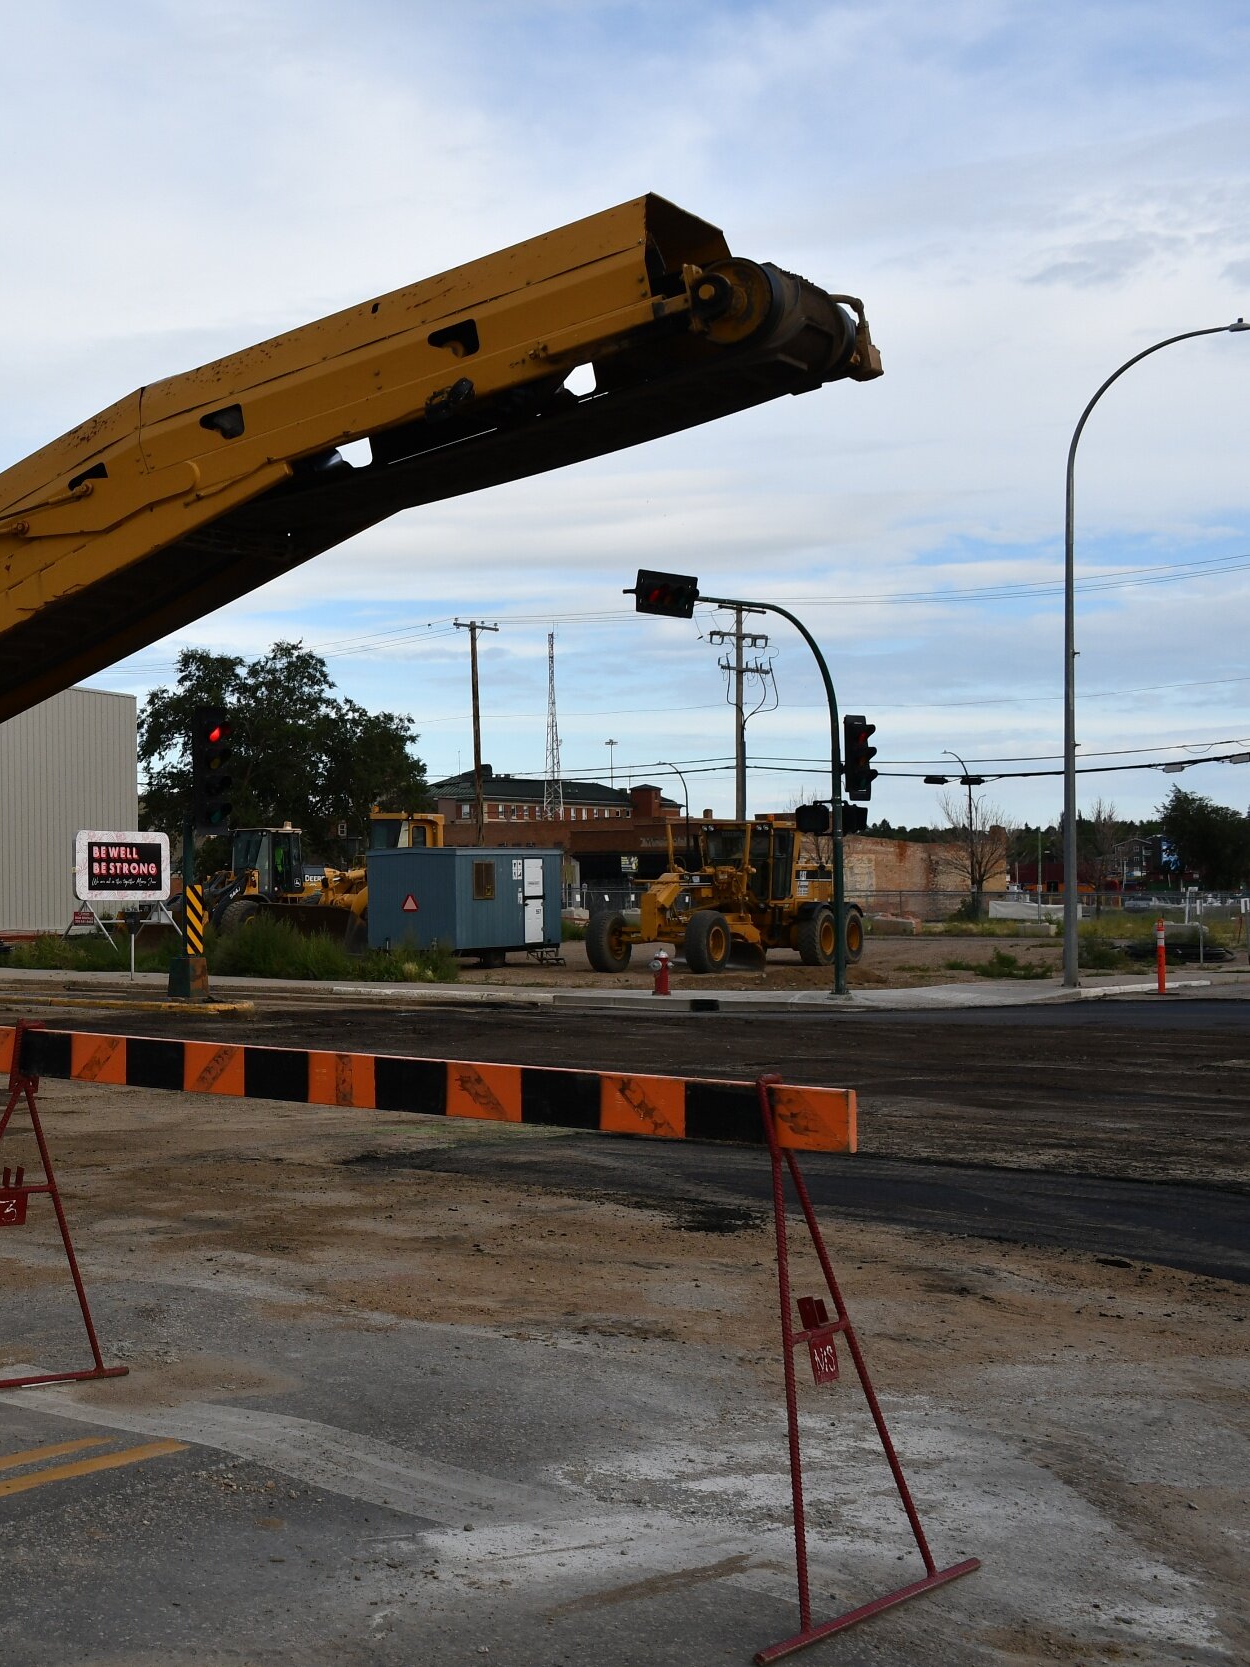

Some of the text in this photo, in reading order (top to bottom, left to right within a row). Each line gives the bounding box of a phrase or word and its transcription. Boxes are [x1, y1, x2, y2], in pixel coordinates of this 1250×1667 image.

[92, 846, 139, 860] BE WELL
[92, 863, 157, 876] BE STRONG
